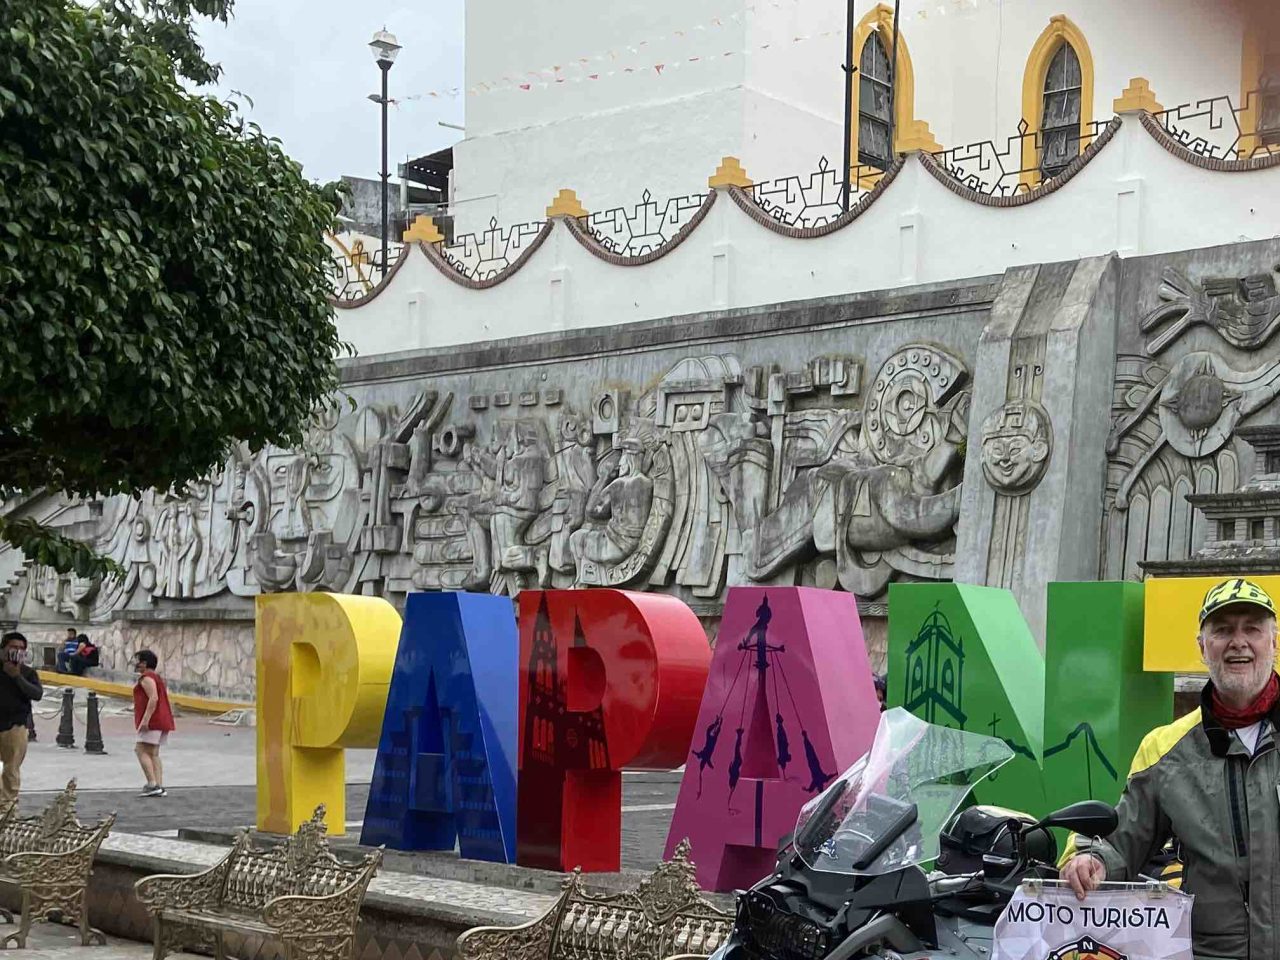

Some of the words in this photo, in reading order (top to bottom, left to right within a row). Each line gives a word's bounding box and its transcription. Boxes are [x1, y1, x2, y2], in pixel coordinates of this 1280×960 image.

[1008, 902, 1073, 925] MOTO
[1080, 907, 1170, 929] TURISTA
[1082, 941, 1093, 950] N
